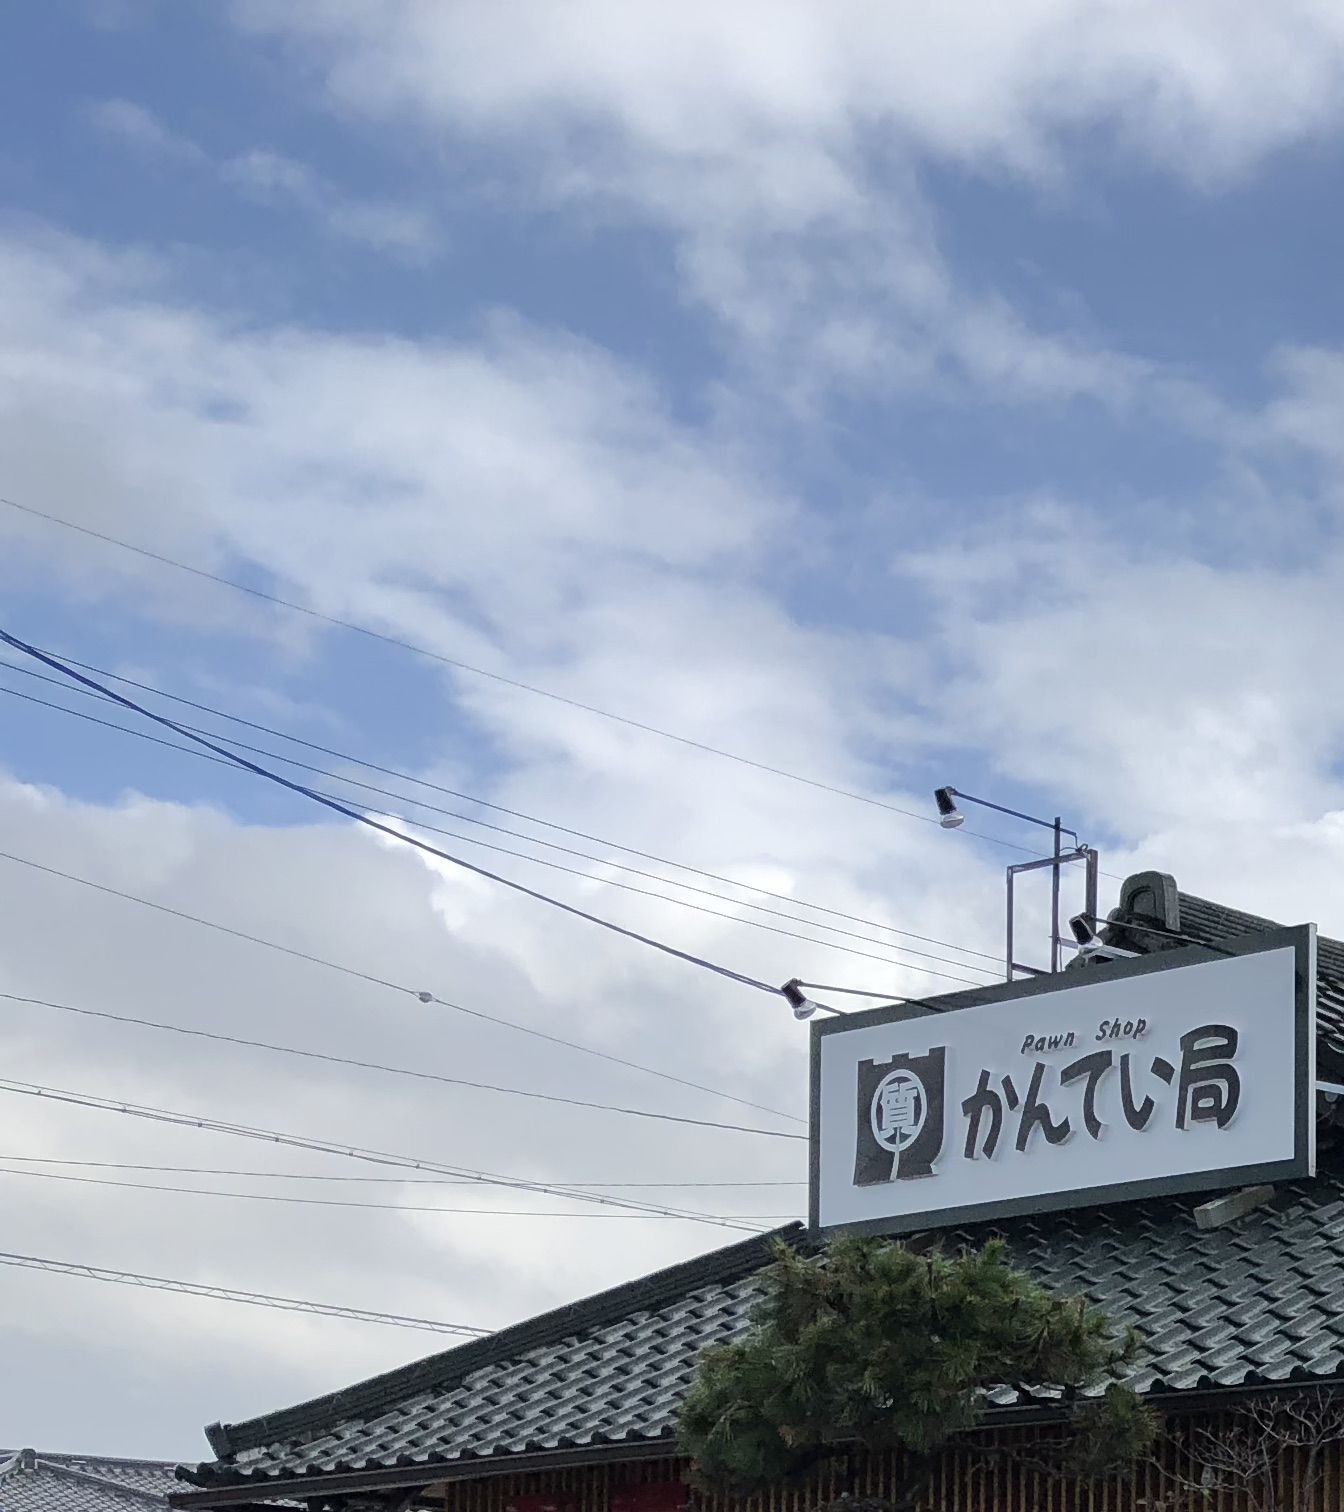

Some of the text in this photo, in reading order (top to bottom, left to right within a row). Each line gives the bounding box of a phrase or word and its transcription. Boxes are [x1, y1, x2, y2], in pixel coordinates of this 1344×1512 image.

[1020, 1017, 1147, 1054] Pawn Shop
[960, 1024, 1241, 1161] かんてい局
